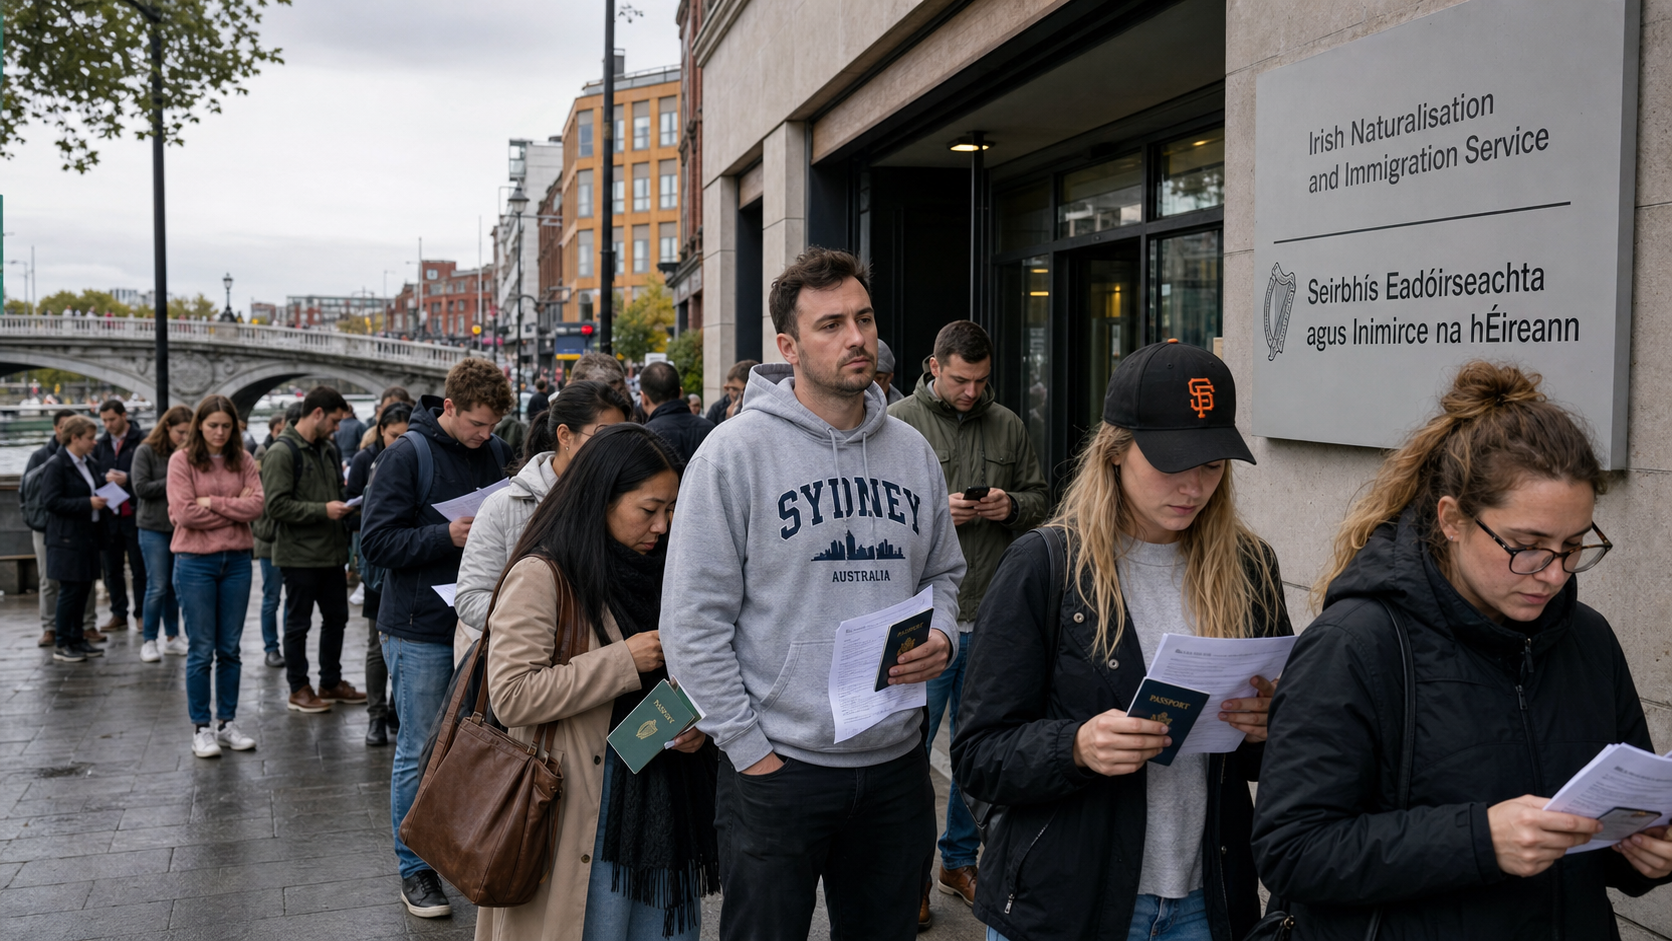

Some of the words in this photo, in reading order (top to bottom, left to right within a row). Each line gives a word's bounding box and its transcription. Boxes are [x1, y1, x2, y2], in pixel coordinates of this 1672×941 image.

[1309, 125, 1345, 156] Irish
[1351, 93, 1494, 146] Naturalisation
[1308, 164, 1339, 194] and
[1345, 145, 1458, 186] Immigration
[1465, 126, 1550, 165] Service
[1307, 273, 1379, 306] Seirbhís
[1386, 262, 1545, 301] Eadóirseachta
[1306, 325, 1347, 352] agus
[1353, 317, 1429, 346] Inimirce
[1436, 321, 1462, 345] na
[1470, 304, 1580, 344] hÉireann
[1188, 377, 1215, 418] SF
[777, 476, 921, 540] SYDNEY
[832, 569, 891, 583] AUSTRALIA
[1149, 694, 1191, 710] PASSPORT
